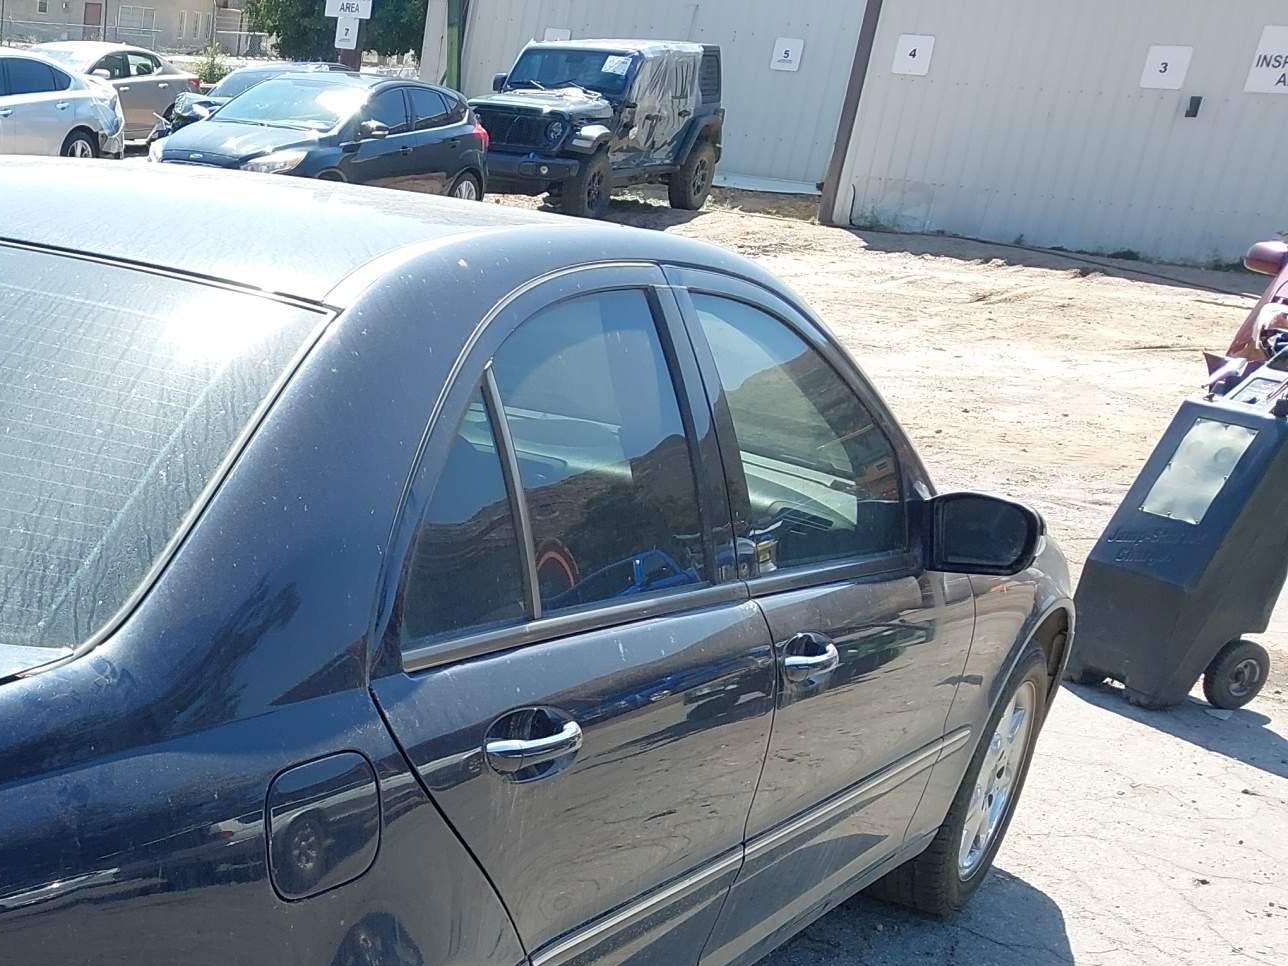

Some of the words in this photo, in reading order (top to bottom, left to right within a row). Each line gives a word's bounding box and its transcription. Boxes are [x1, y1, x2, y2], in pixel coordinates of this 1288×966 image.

[339, 2, 360, 13] AREA
[344, 28, 350, 37] 7
[783, 49, 791, 59] 5
[908, 48, 917, 59] 4
[1159, 62, 1169, 74] 3
